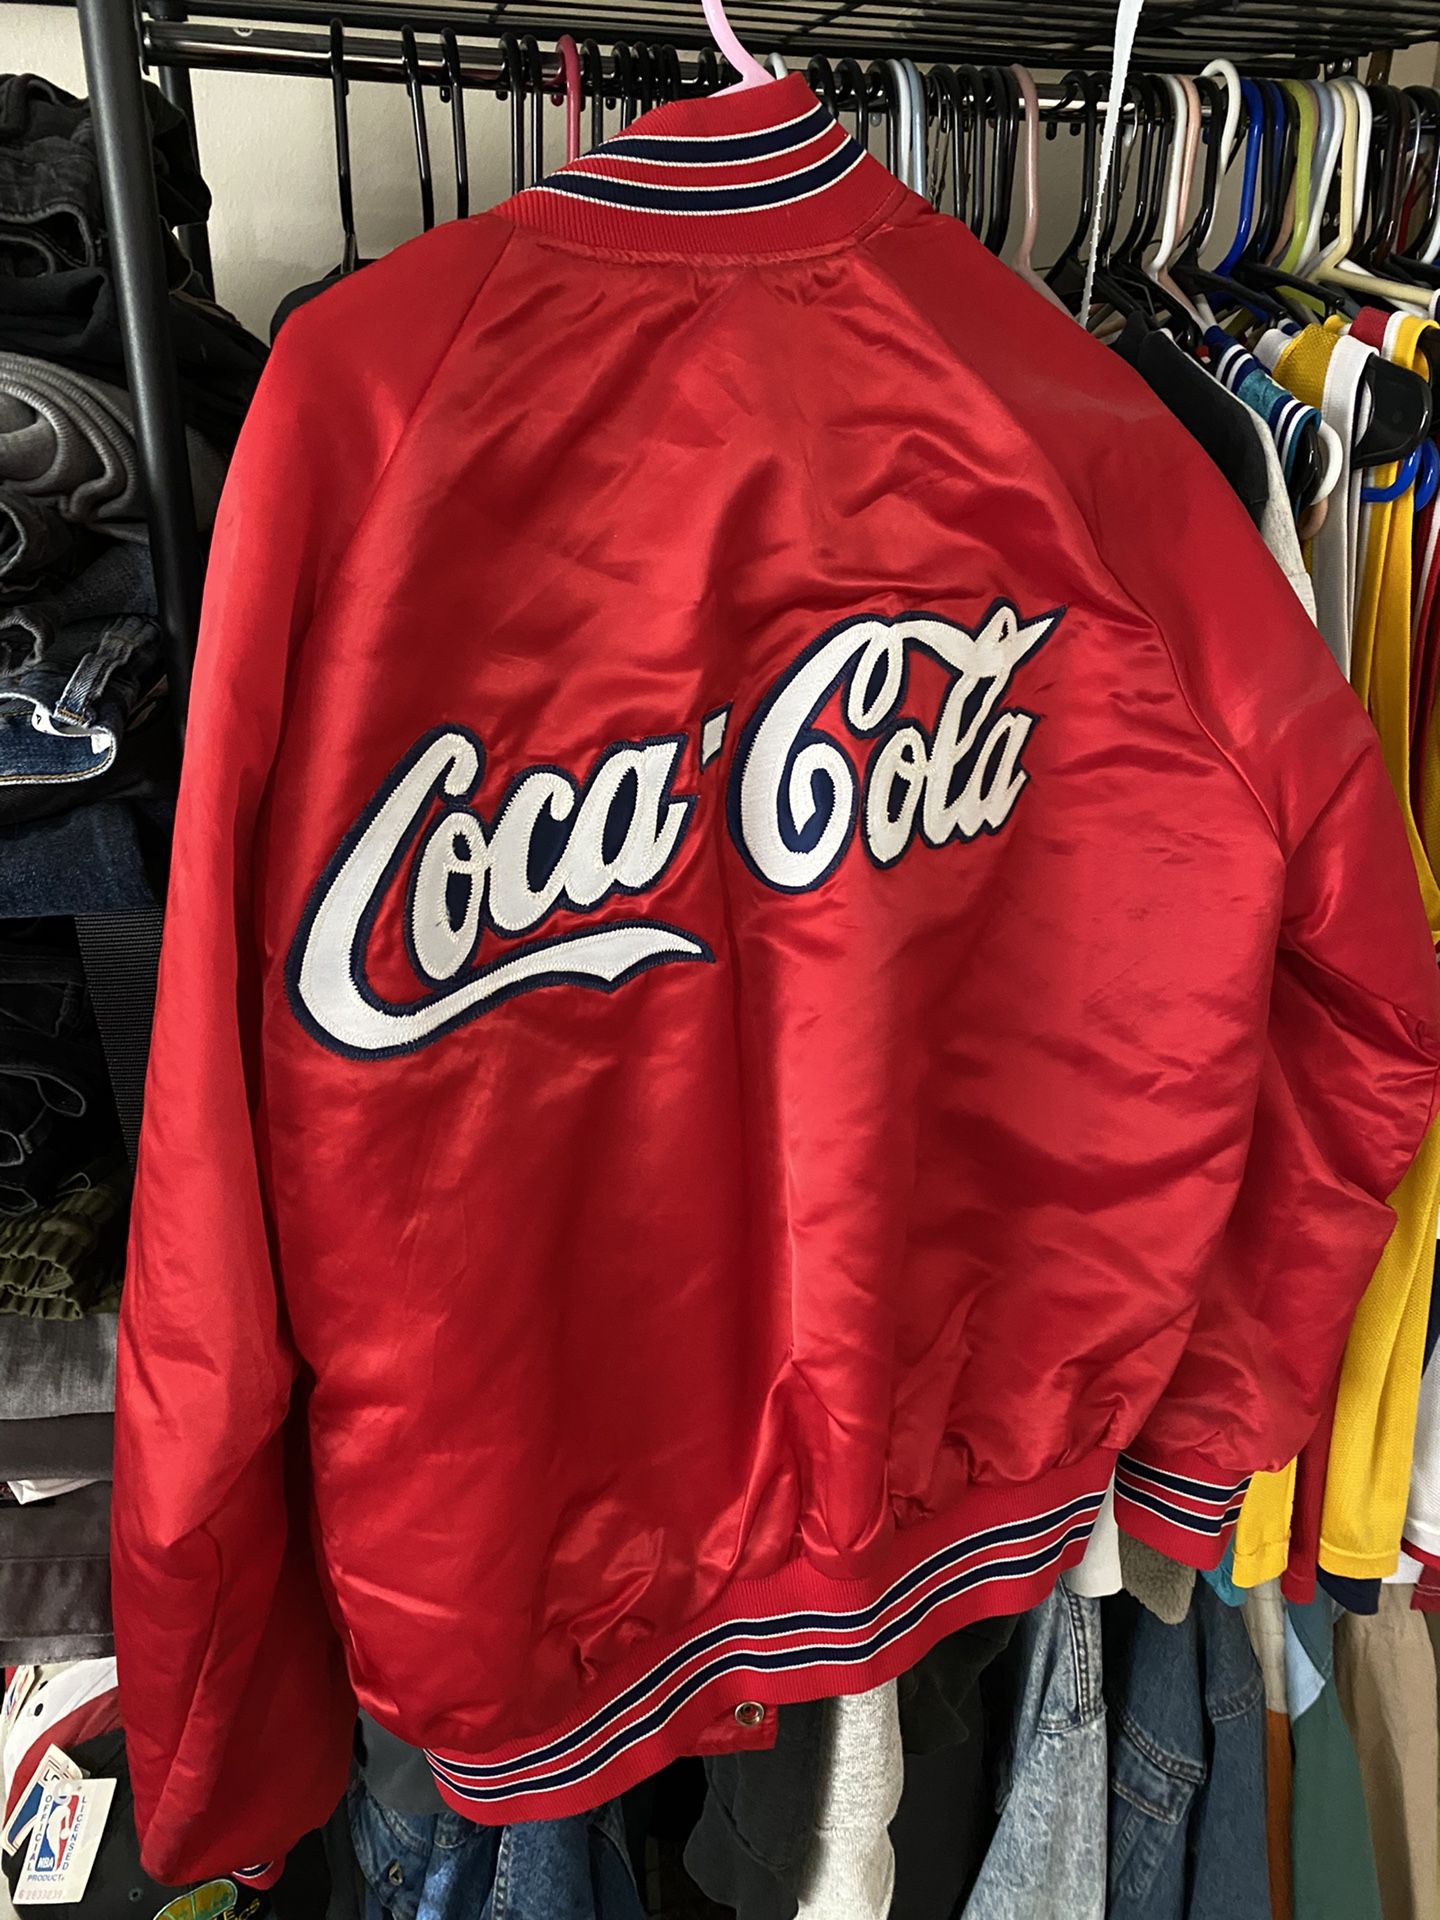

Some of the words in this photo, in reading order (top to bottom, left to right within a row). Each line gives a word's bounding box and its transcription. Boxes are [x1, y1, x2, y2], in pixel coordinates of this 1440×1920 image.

[287, 597, 1066, 1061] Coca-Cola
[27, 1795, 53, 1871] OFFICIAL
[37, 1856, 54, 1869] NBA
[62, 1796, 87, 1870] LICENSED
